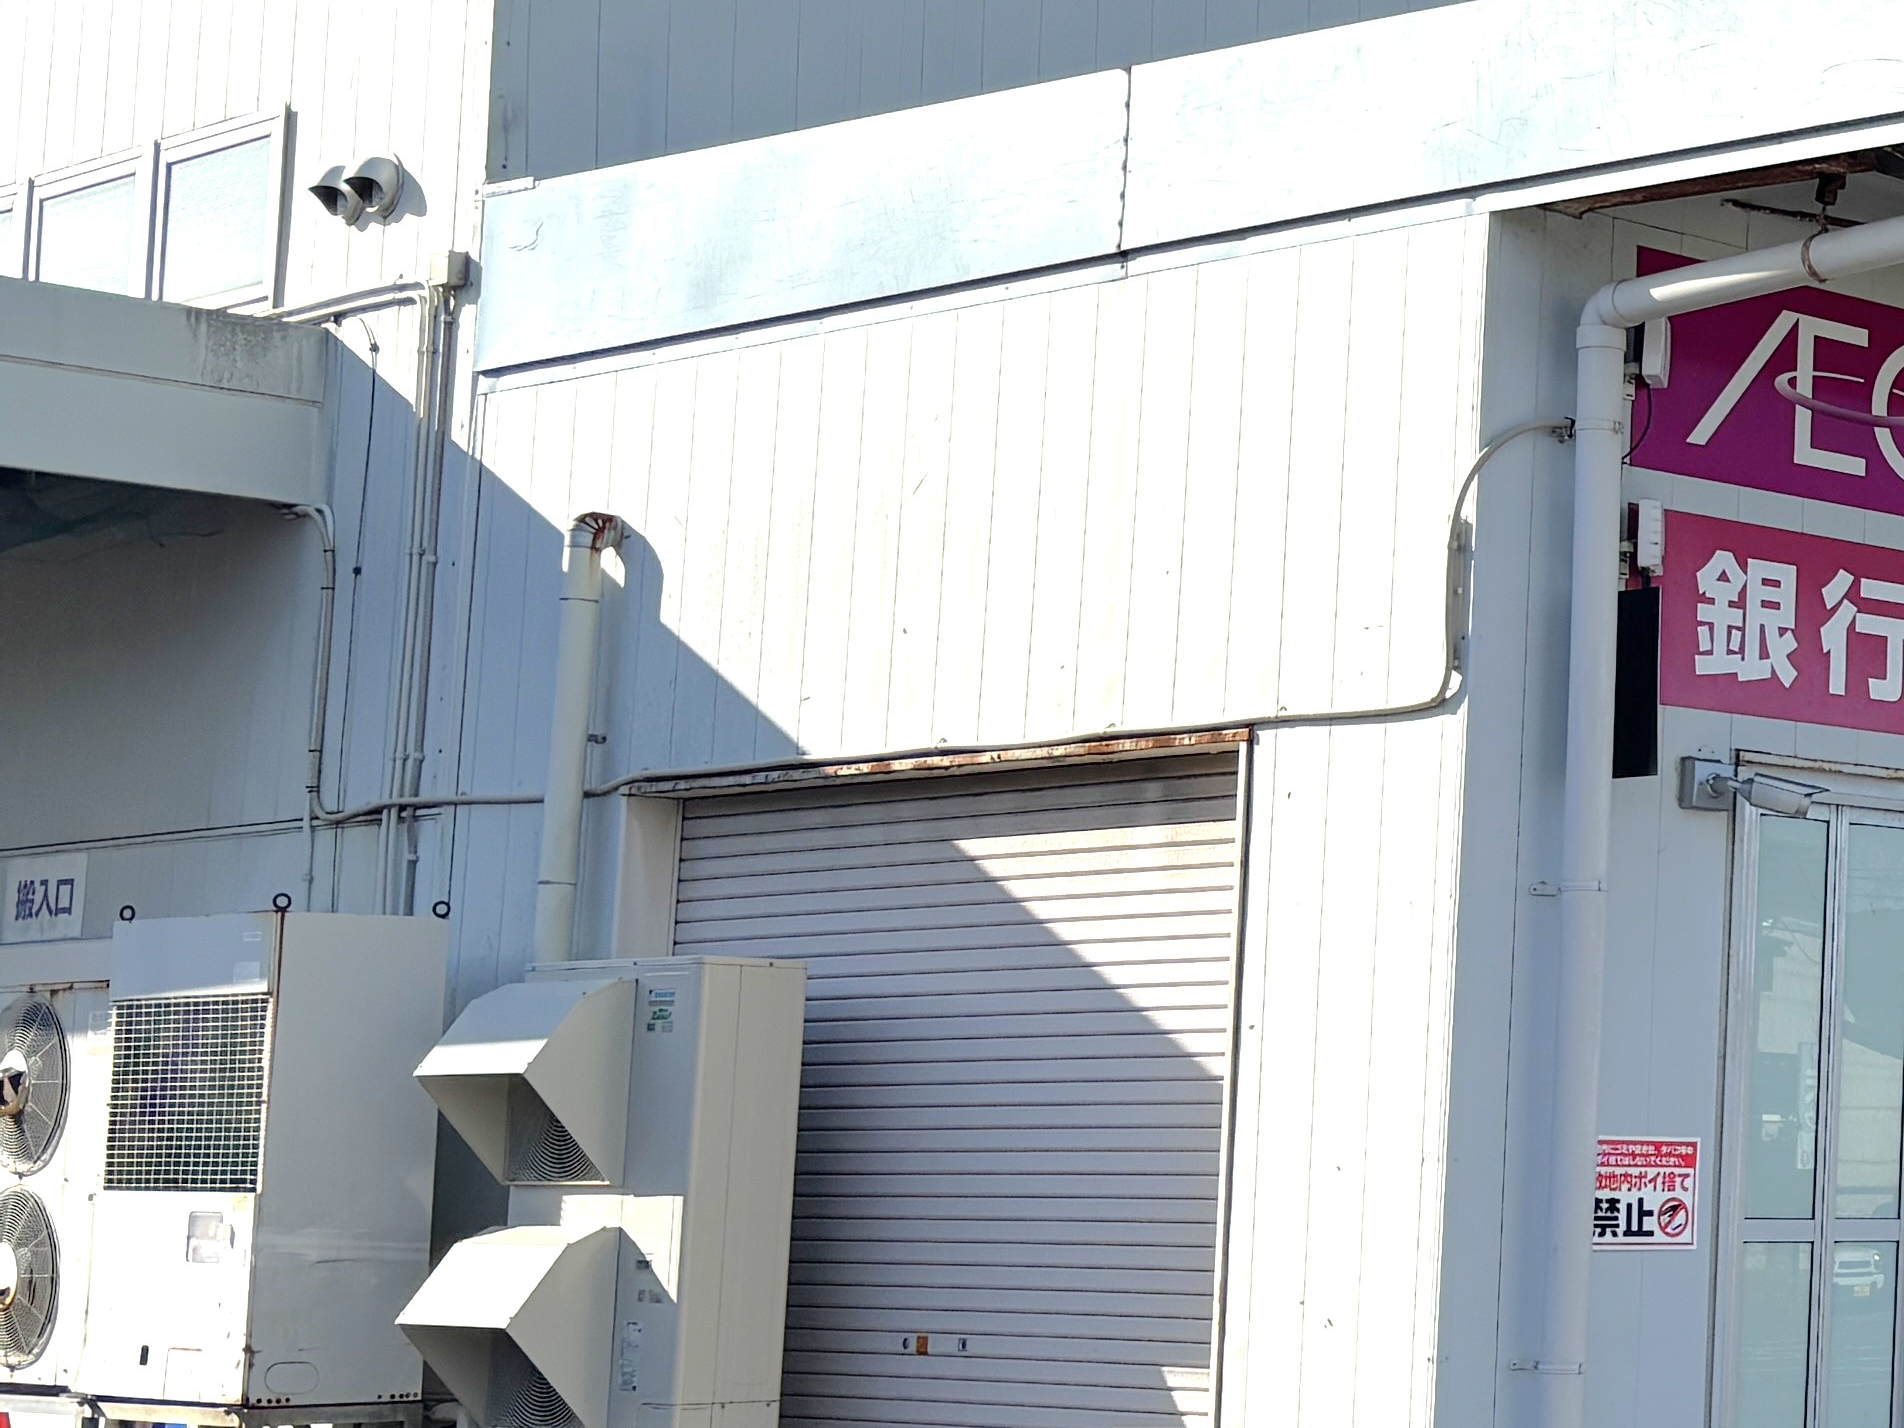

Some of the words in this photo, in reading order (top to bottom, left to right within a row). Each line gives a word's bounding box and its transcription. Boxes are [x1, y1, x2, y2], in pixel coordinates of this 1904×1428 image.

[15, 878, 75, 921] 搬入口
[1592, 1196, 1655, 1238] 禁止
